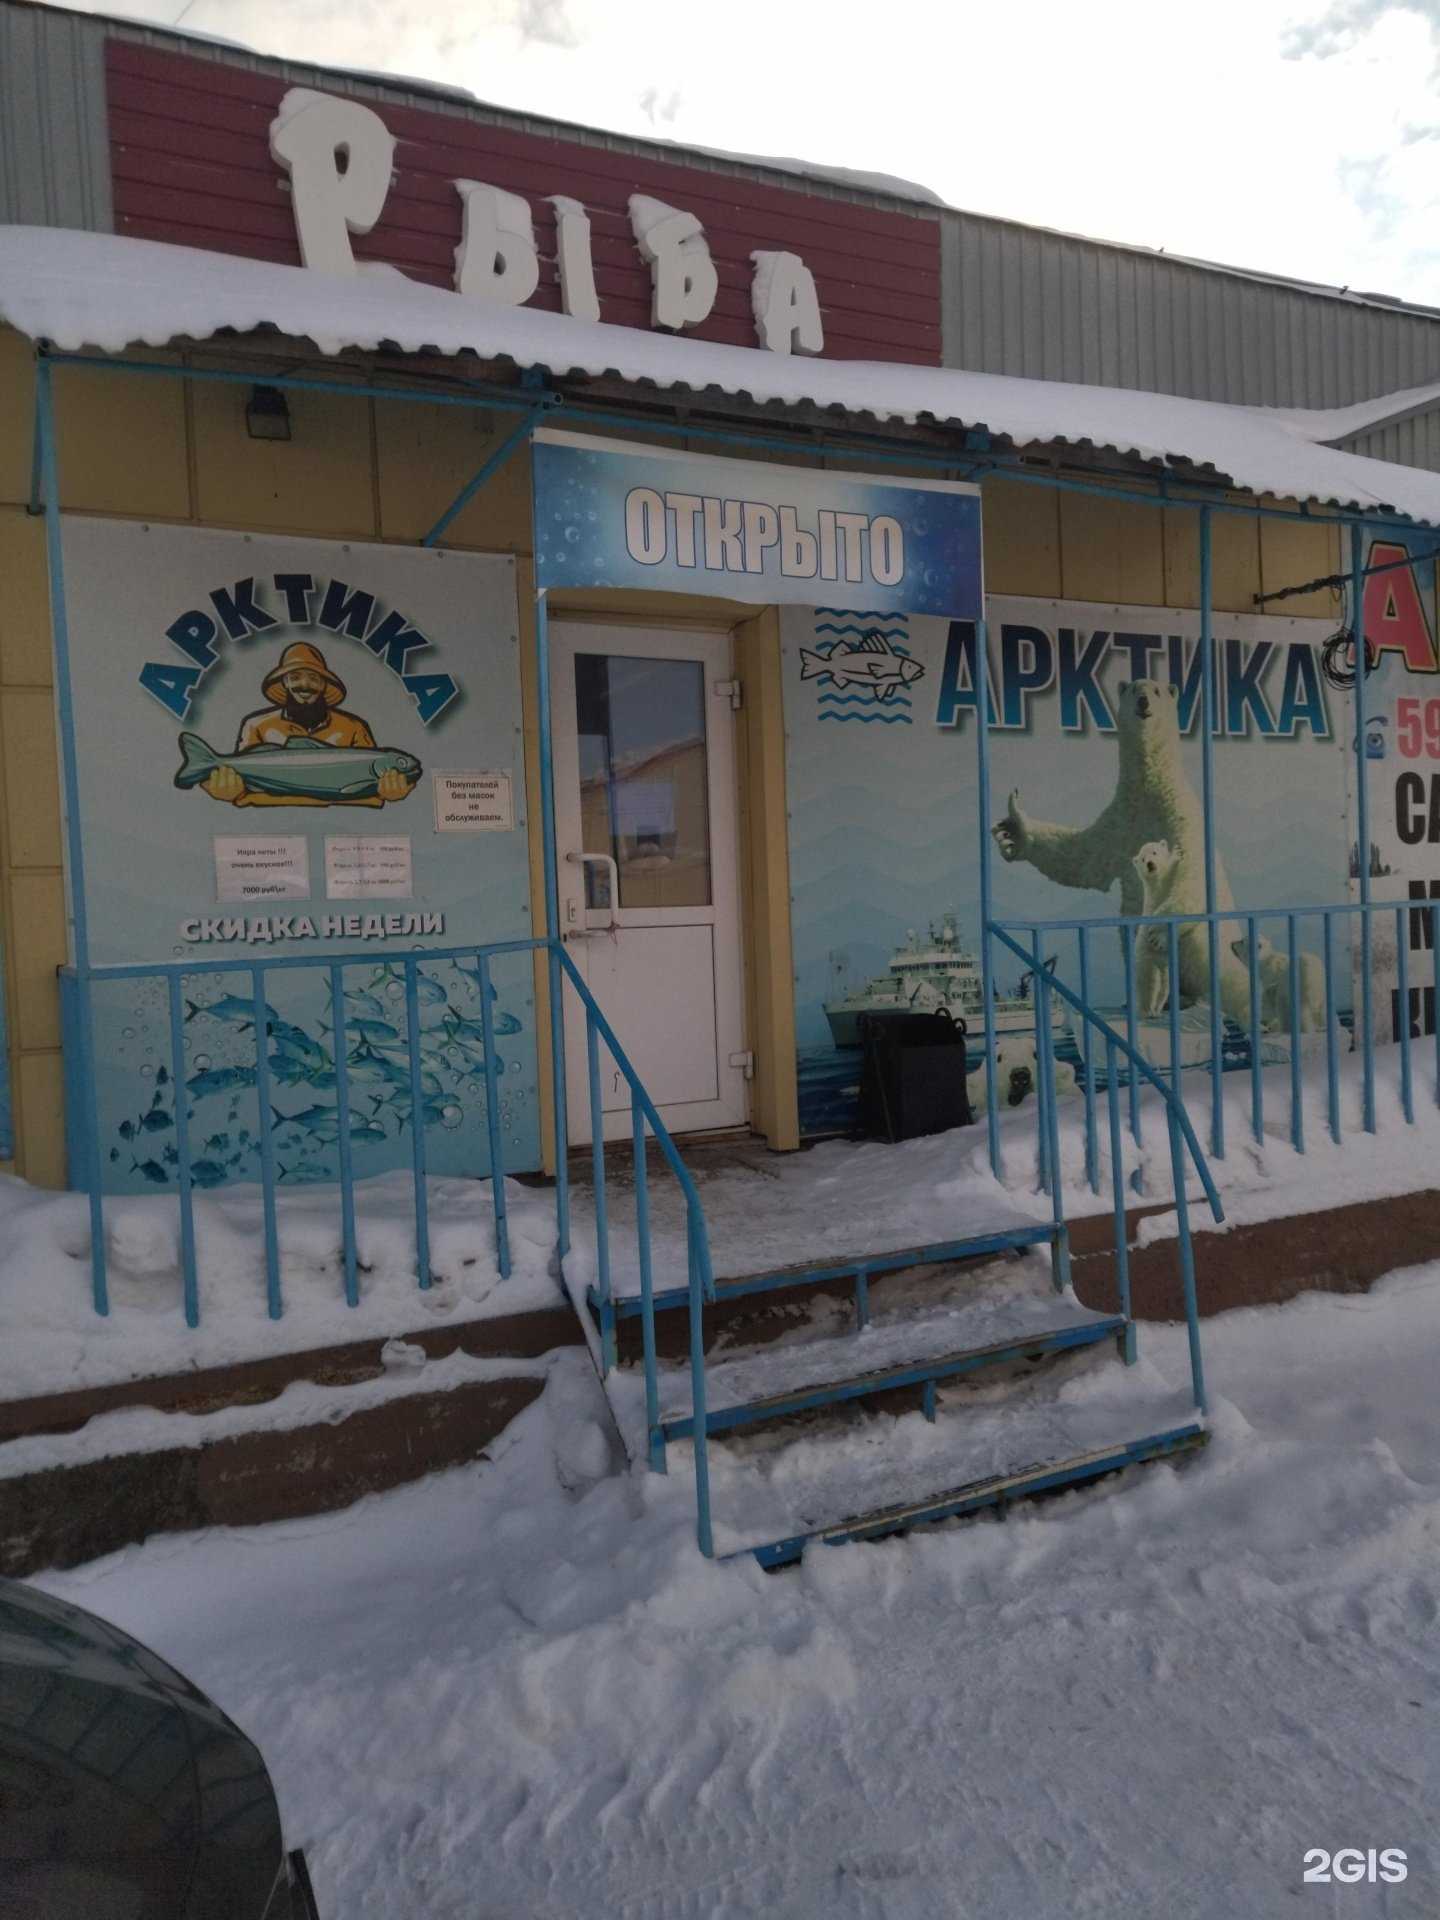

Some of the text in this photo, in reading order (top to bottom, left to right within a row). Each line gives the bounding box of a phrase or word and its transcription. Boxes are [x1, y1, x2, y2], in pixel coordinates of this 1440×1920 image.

[625, 487, 904, 587] ОТКРЫТО
[1346, 541, 1440, 674] А
[138, 574, 460, 725] АРКТИКА
[935, 620, 1330, 738] АРКТИКА
[445, 780, 500, 790] Покупателей
[451, 791, 496, 800] без масок
[468, 803, 480, 811] не
[179, 911, 447, 945] СКИДКА НЕДЕЛИ
